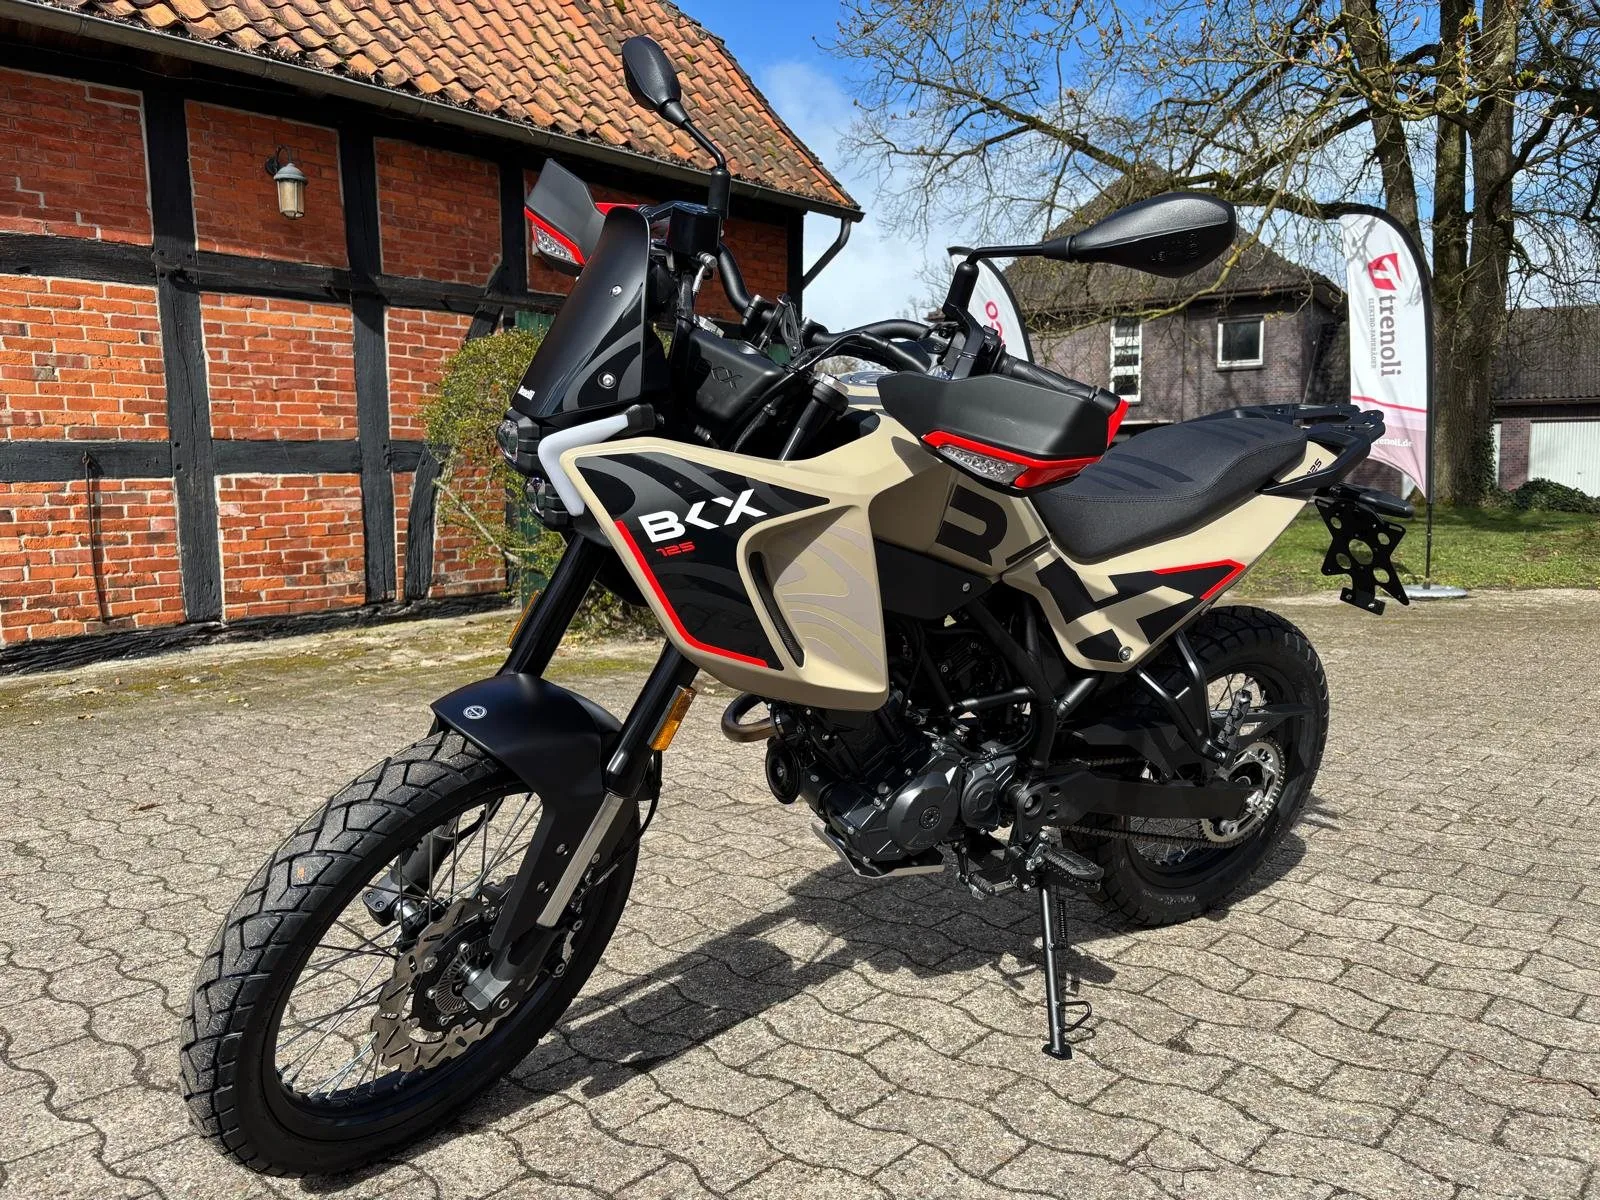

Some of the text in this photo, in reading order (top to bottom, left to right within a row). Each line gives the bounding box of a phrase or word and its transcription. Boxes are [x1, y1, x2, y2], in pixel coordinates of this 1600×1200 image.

[1379, 294, 1402, 377] trenoli
[1374, 437, 1413, 447] renoli.de
[638, 488, 767, 543] BKX
[656, 541, 696, 557] 125
